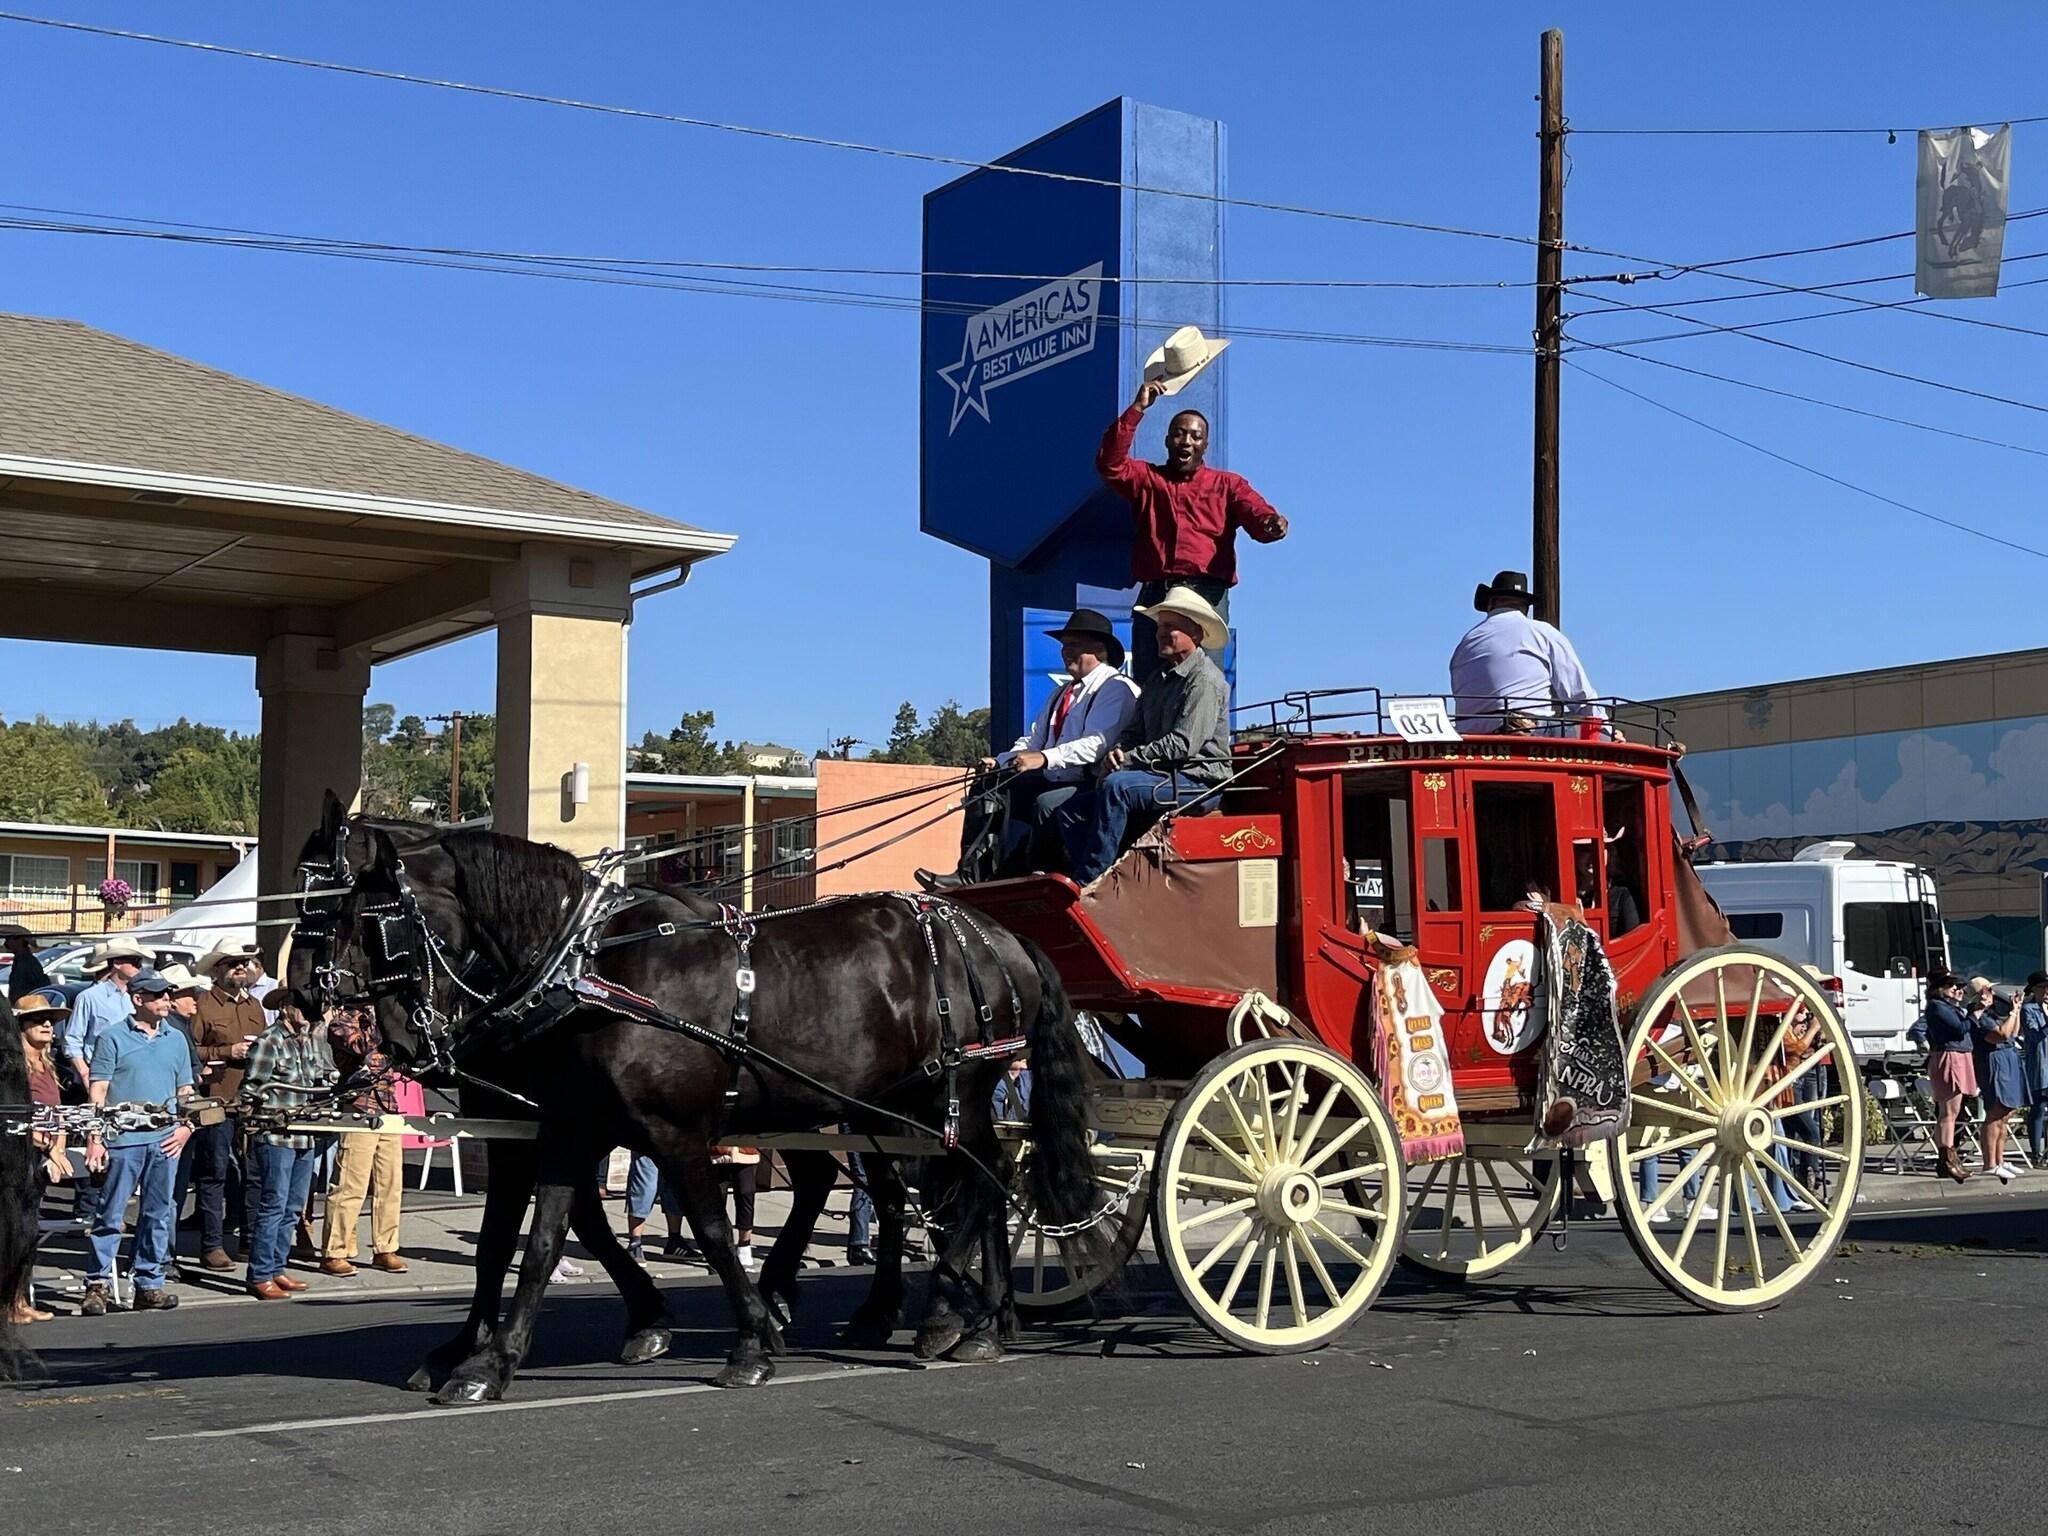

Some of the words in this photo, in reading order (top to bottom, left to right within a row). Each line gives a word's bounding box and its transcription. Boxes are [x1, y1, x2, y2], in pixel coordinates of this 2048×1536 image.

[977, 280, 1091, 354] AMERICAS
[983, 354, 1013, 380] BEST
[1015, 336, 1057, 368] VALUE
[1062, 323, 1088, 350] INN
[1400, 713, 1443, 734] 037
[1347, 744, 1512, 763] PENDLETON
[1527, 744, 1604, 765] ROUND
[1559, 1065, 1614, 1106] NPRA
